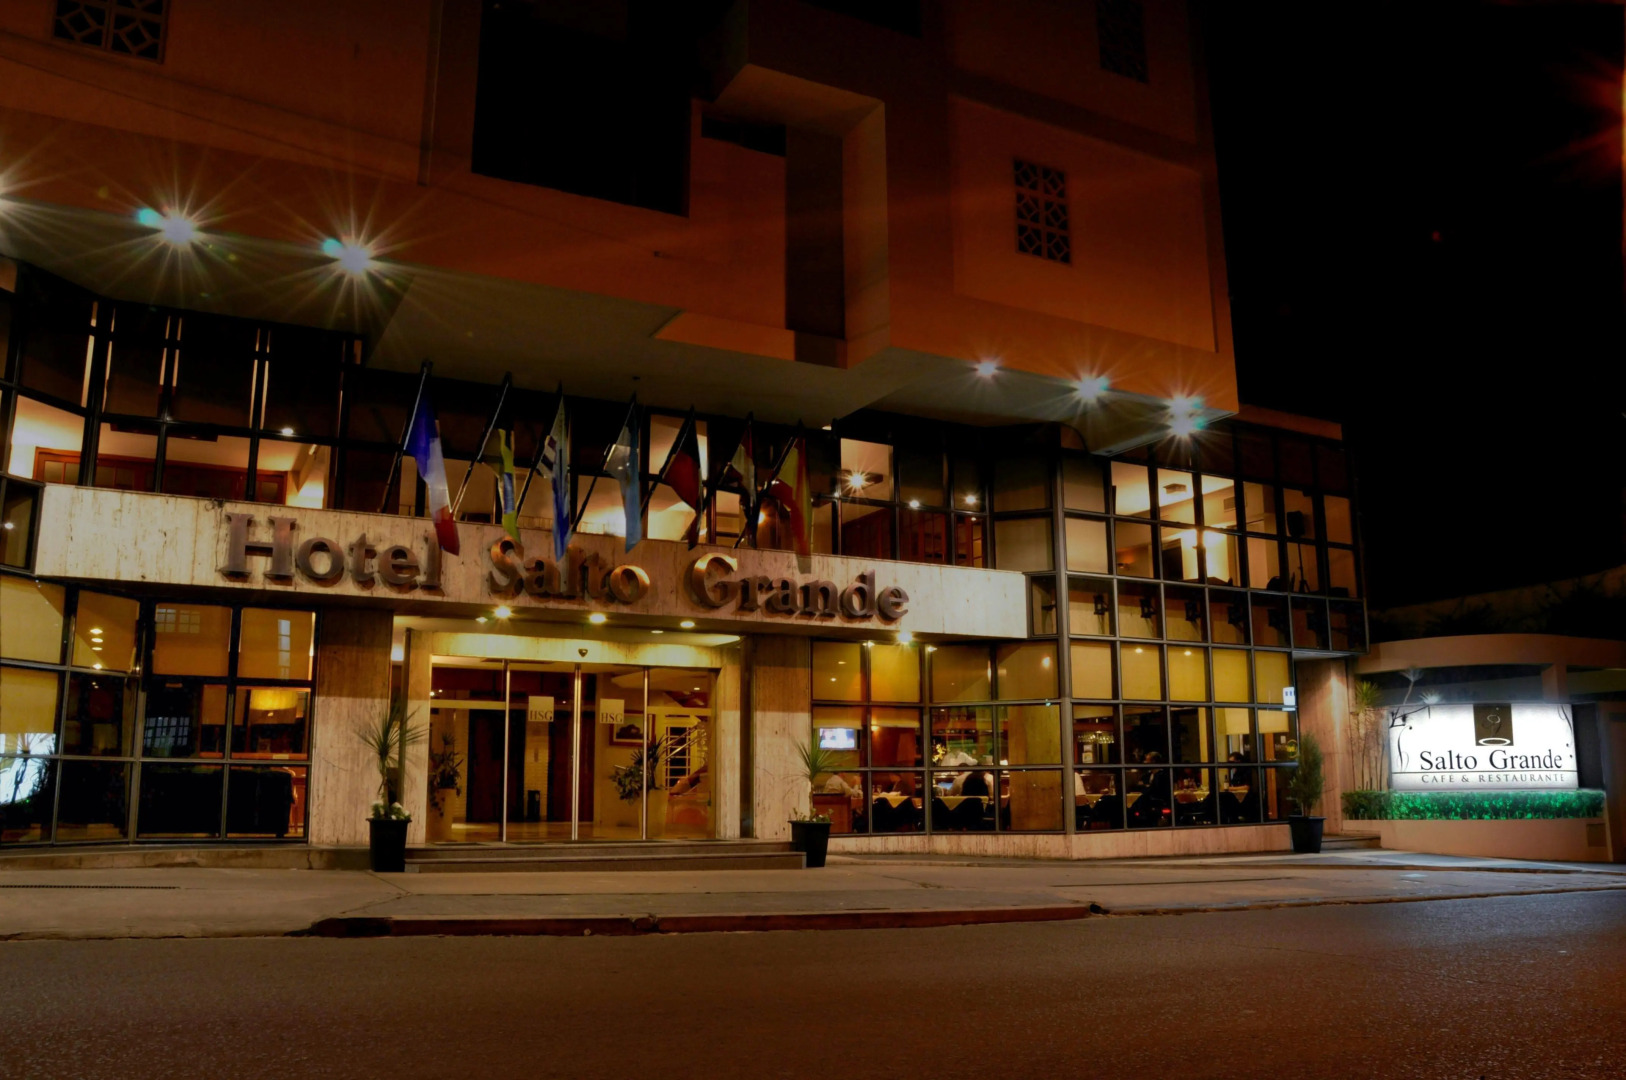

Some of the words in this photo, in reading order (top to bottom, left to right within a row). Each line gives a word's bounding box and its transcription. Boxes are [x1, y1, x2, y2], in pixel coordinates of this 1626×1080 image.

[217, 513, 444, 594] Hotel
[482, 536, 651, 604] Salto
[686, 552, 909, 622] Grande
[530, 710, 553, 721] HSG
[601, 712, 623, 723] HSG
[1420, 750, 1477, 770] Salto
[1489, 749, 1562, 769] Grande
[1461, 774, 1470, 783] &
[1478, 773, 1565, 783] RESTAURANTE
